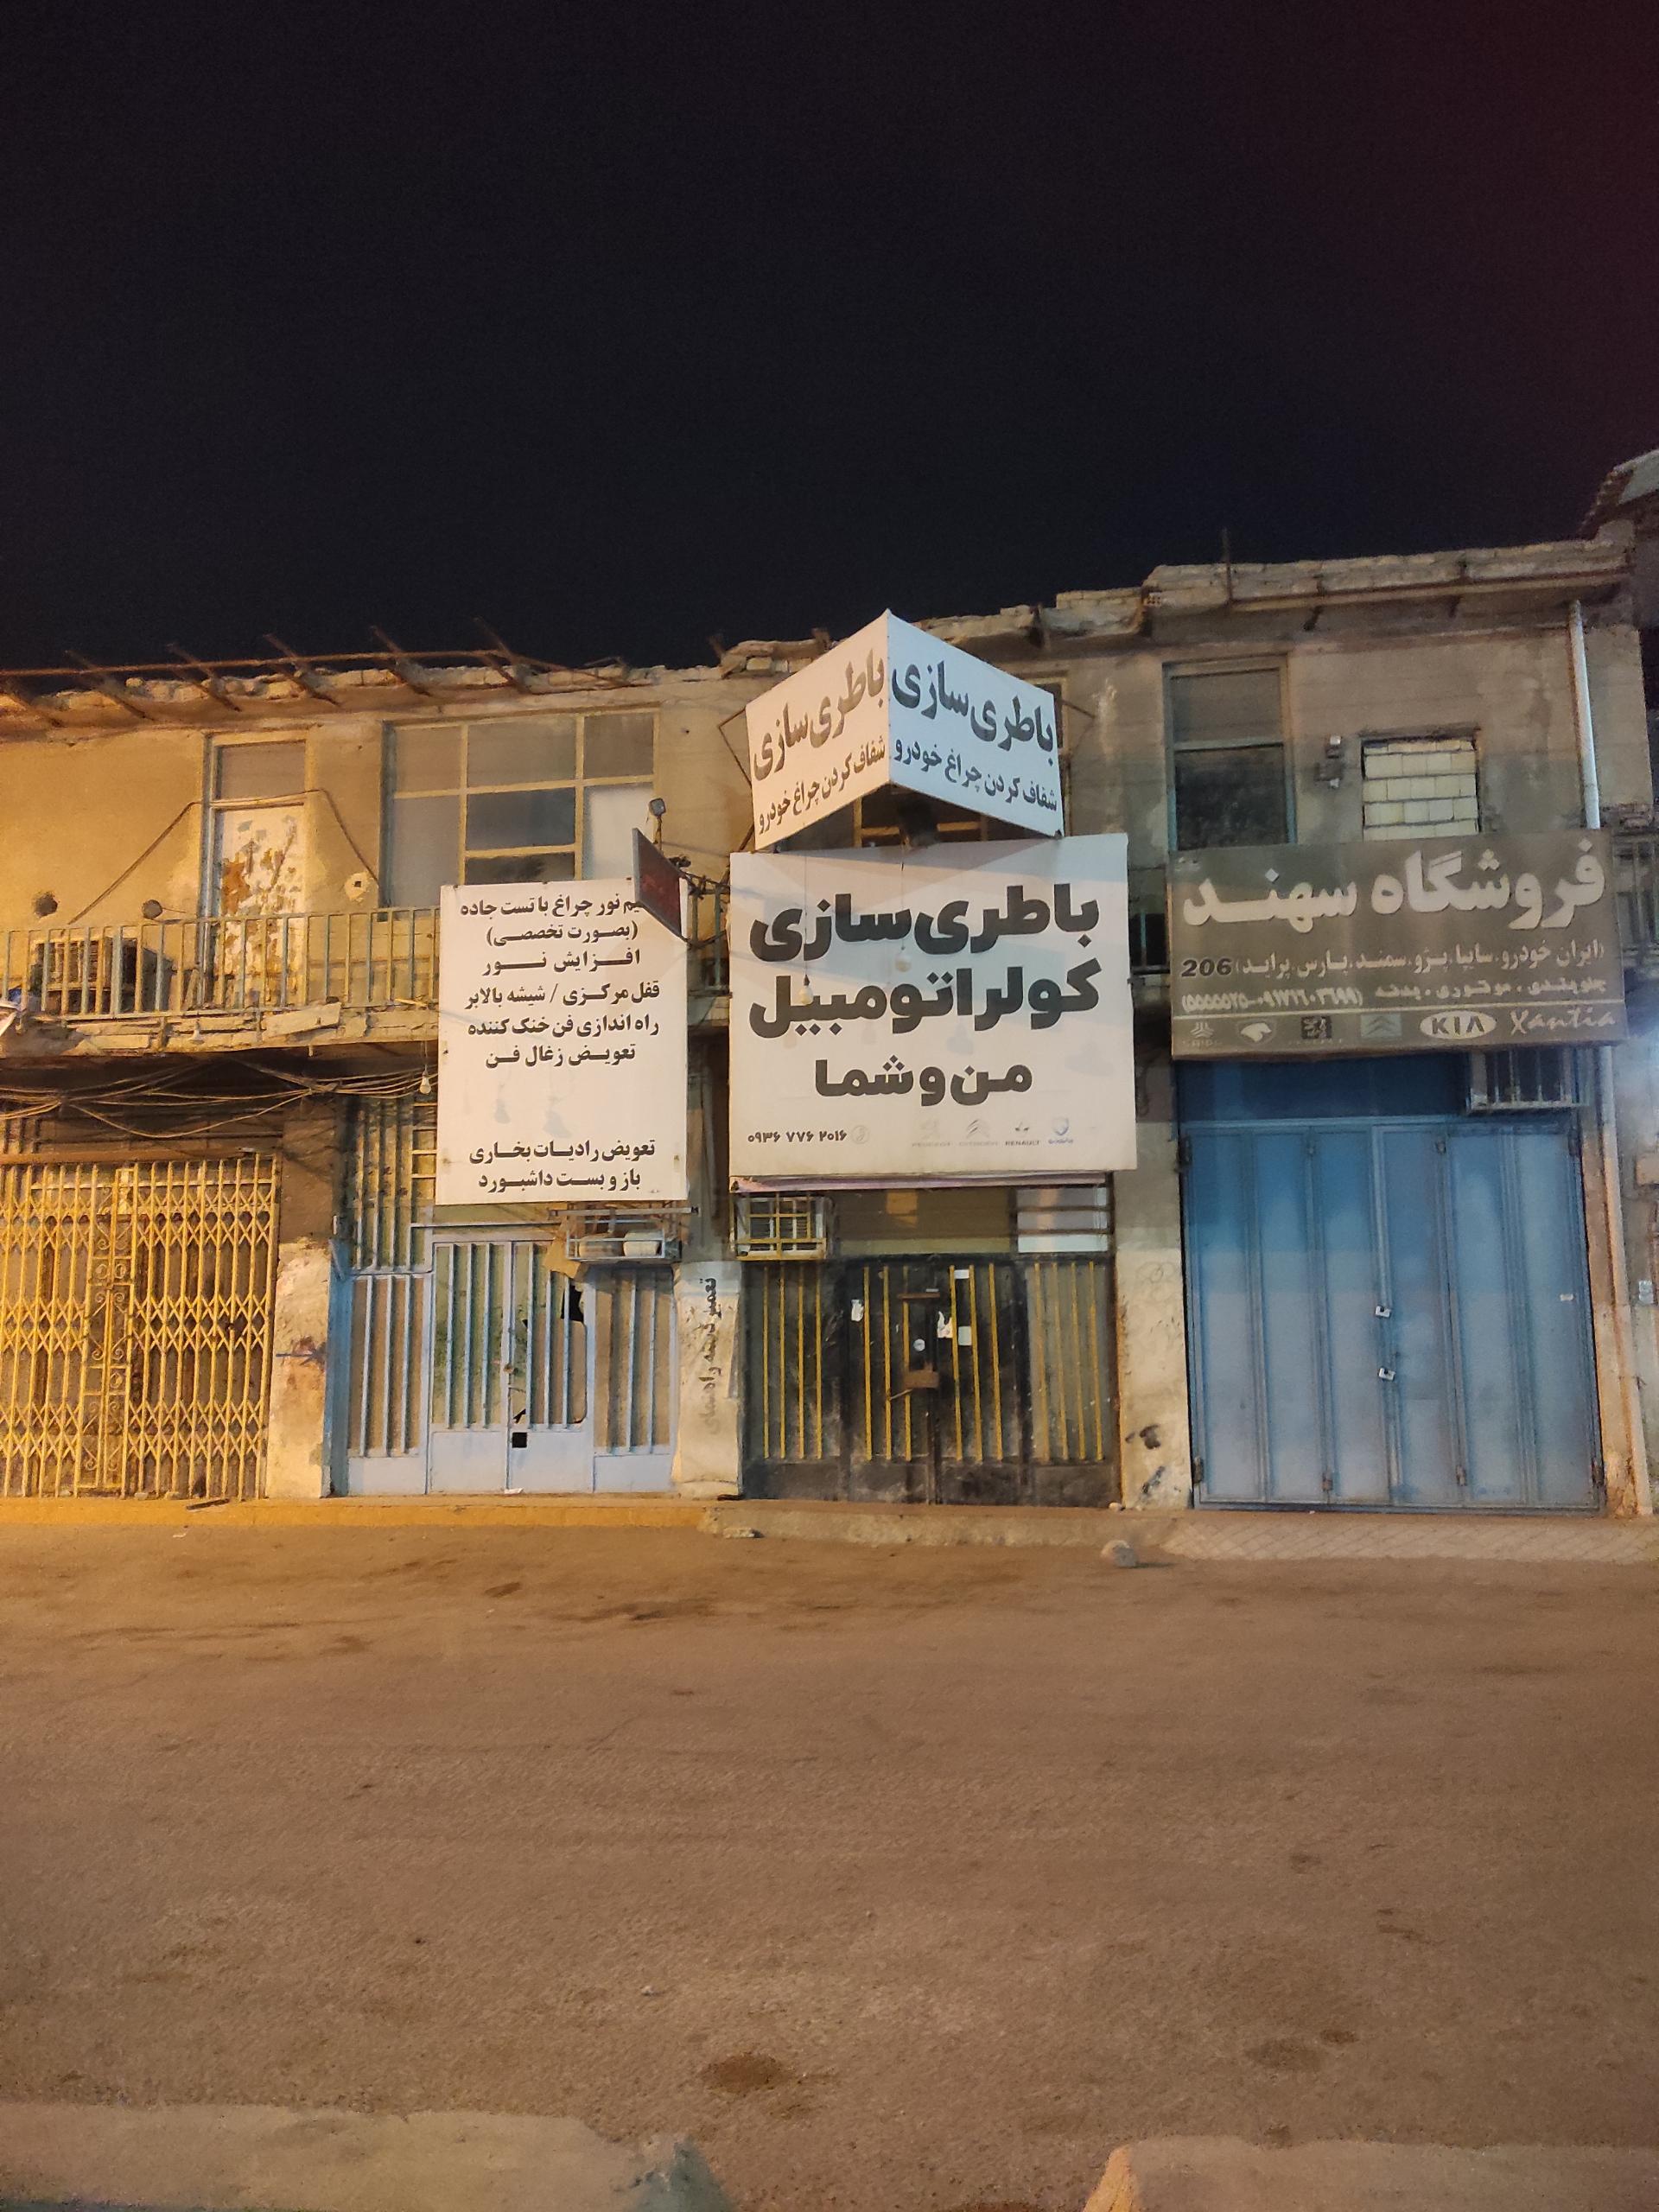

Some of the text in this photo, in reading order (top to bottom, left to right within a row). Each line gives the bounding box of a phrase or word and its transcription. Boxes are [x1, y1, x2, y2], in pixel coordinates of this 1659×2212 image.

[754, 647, 884, 780] باطری سازی
[892, 661, 1053, 766] باطری سازی
[760, 736, 885, 835] شفاف کردن چراغ خودرو
[894, 740, 1057, 810] شفاف کردن چراغ خودرو
[1182, 838, 1605, 932] فروشگاه سهند
[461, 900, 497, 918] جاده
[501, 898, 534, 914] تست
[538, 896, 548, 916] با
[552, 894, 593, 917] چراغ
[596, 893, 620, 916] نور
[750, 883, 1099, 962] باطری سازی
[482, 948, 639, 976] افزایش نور
[1181, 957, 1233, 978] 206
[465, 988, 502, 1009] بالابر
[507, 986, 545, 1006] شیشه
[563, 983, 628, 1006] مرکزی
[632, 981, 659, 1003] قفل
[749, 958, 1102, 1038] کولر اتومبیل
[468, 1014, 658, 1038] راه اندازی فن خنک کننده
[1432, 1015, 1484, 1035] KIA
[1511, 1006, 1616, 1035] Xantia
[486, 1044, 635, 1068] تعویض زغال فن
[816, 1055, 1032, 1106] من و شما
[748, 1130, 847, 1142] ۰۹۳۶ ۷۷۶ ۲۰۱۶
[470, 1140, 655, 1164] تعویض رادیات بخاری
[479, 1168, 640, 1192] باز و بست داشبورد
